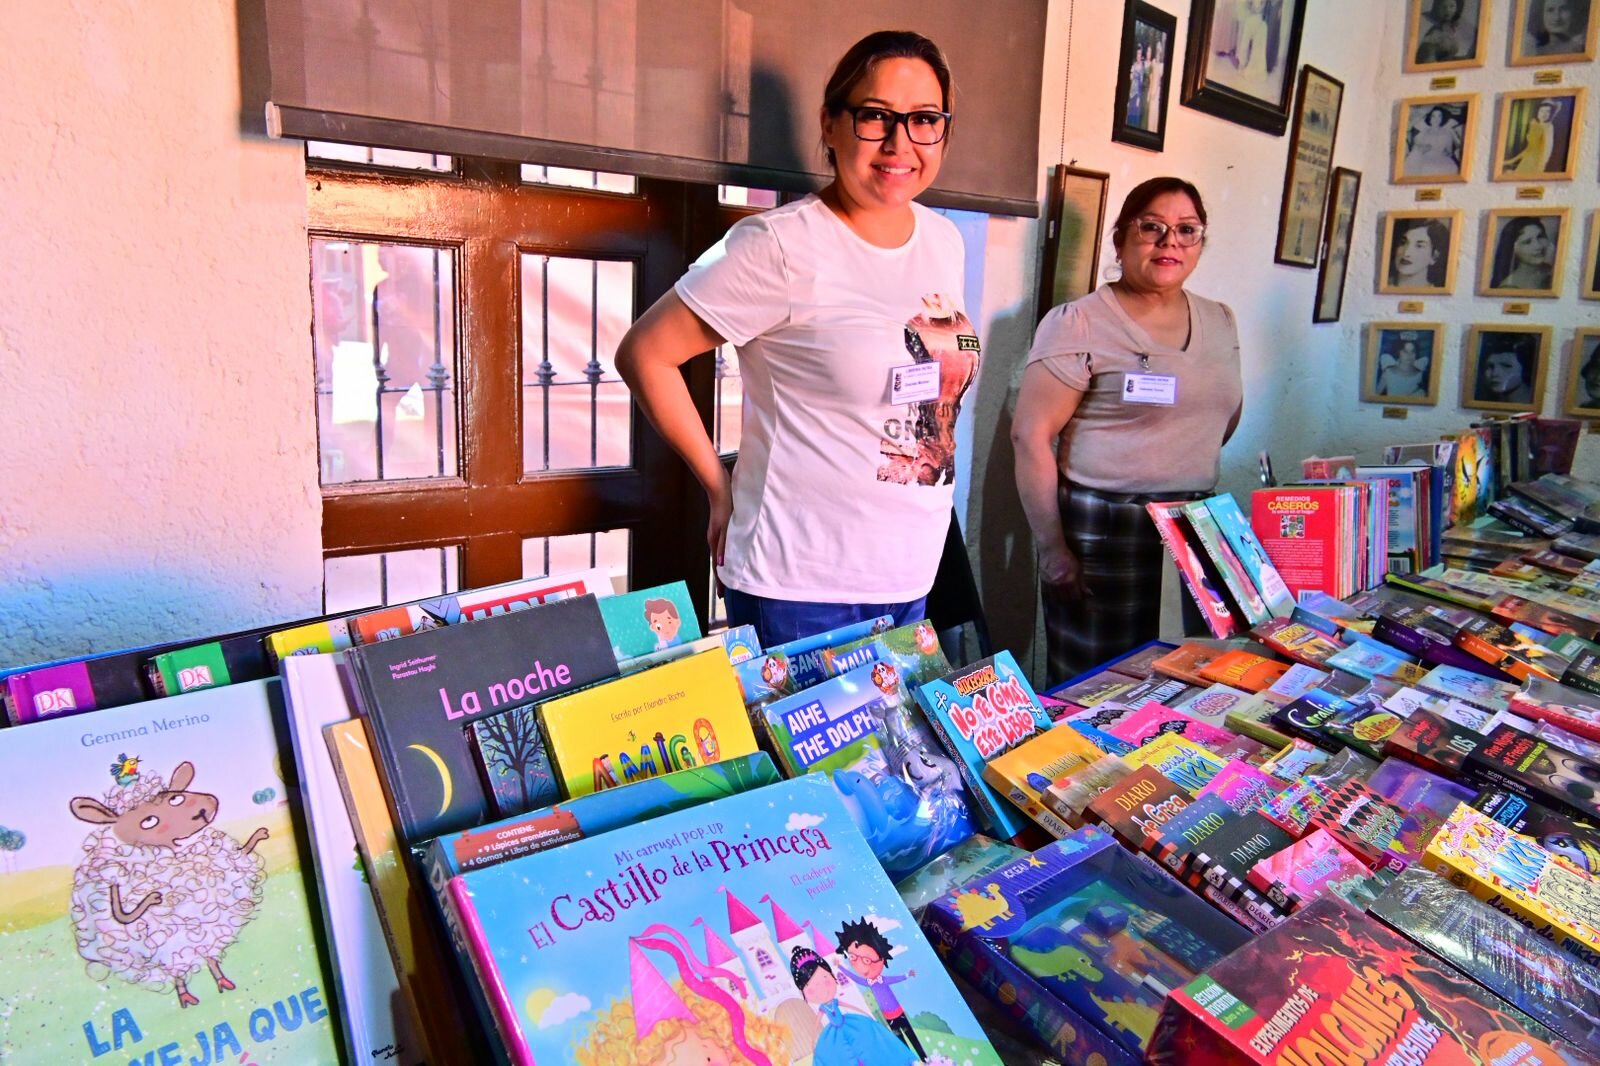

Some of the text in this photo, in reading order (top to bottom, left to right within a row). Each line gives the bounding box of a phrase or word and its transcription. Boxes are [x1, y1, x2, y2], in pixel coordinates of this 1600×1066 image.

[1267, 501, 1320, 511] CASEROS
[181, 667, 210, 690] DK
[439, 660, 572, 721] La noche
[955, 666, 998, 696] MIKECRACK
[38, 689, 75, 712] DK
[950, 677, 1031, 738] NO TE COMAS
[1287, 699, 1343, 729] Coraline
[81, 712, 210, 748] Gemma Merino
[786, 702, 826, 736] AIHE
[975, 727, 1004, 757] ESTE
[999, 711, 1034, 746] LIBRO
[593, 718, 721, 791] AMIGO
[792, 709, 875, 766] THE DOLPH
[1042, 752, 1083, 778] DIARIO
[1115, 779, 1157, 811] DIARIO
[484, 827, 560, 853] 9 Lápices aromáticos
[496, 824, 536, 840] CONTIENE:
[1043, 815, 1070, 838] DIARIO
[1182, 812, 1225, 846] DIARIO
[469, 832, 580, 867] 4 Gomas Libro de actividades
[614, 822, 724, 867] Mi carrusel POP-UP
[1230, 833, 1272, 865] DIARIO
[1297, 854, 1341, 886] DIARIO
[528, 827, 832, 950] El Castillo de la Princesa
[1212, 890, 1235, 910] DIARIO
[1248, 904, 1277, 929] DIARIO
[1486, 894, 1536, 931] diario
[1536, 920, 1556, 941] de
[82, 1007, 143, 1058] LA
[128, 986, 328, 1066] EJA QUE
[1250, 984, 1320, 1056] EXPERIMENTOS DE
[1383, 1016, 1444, 1066] PLOSIVOS
